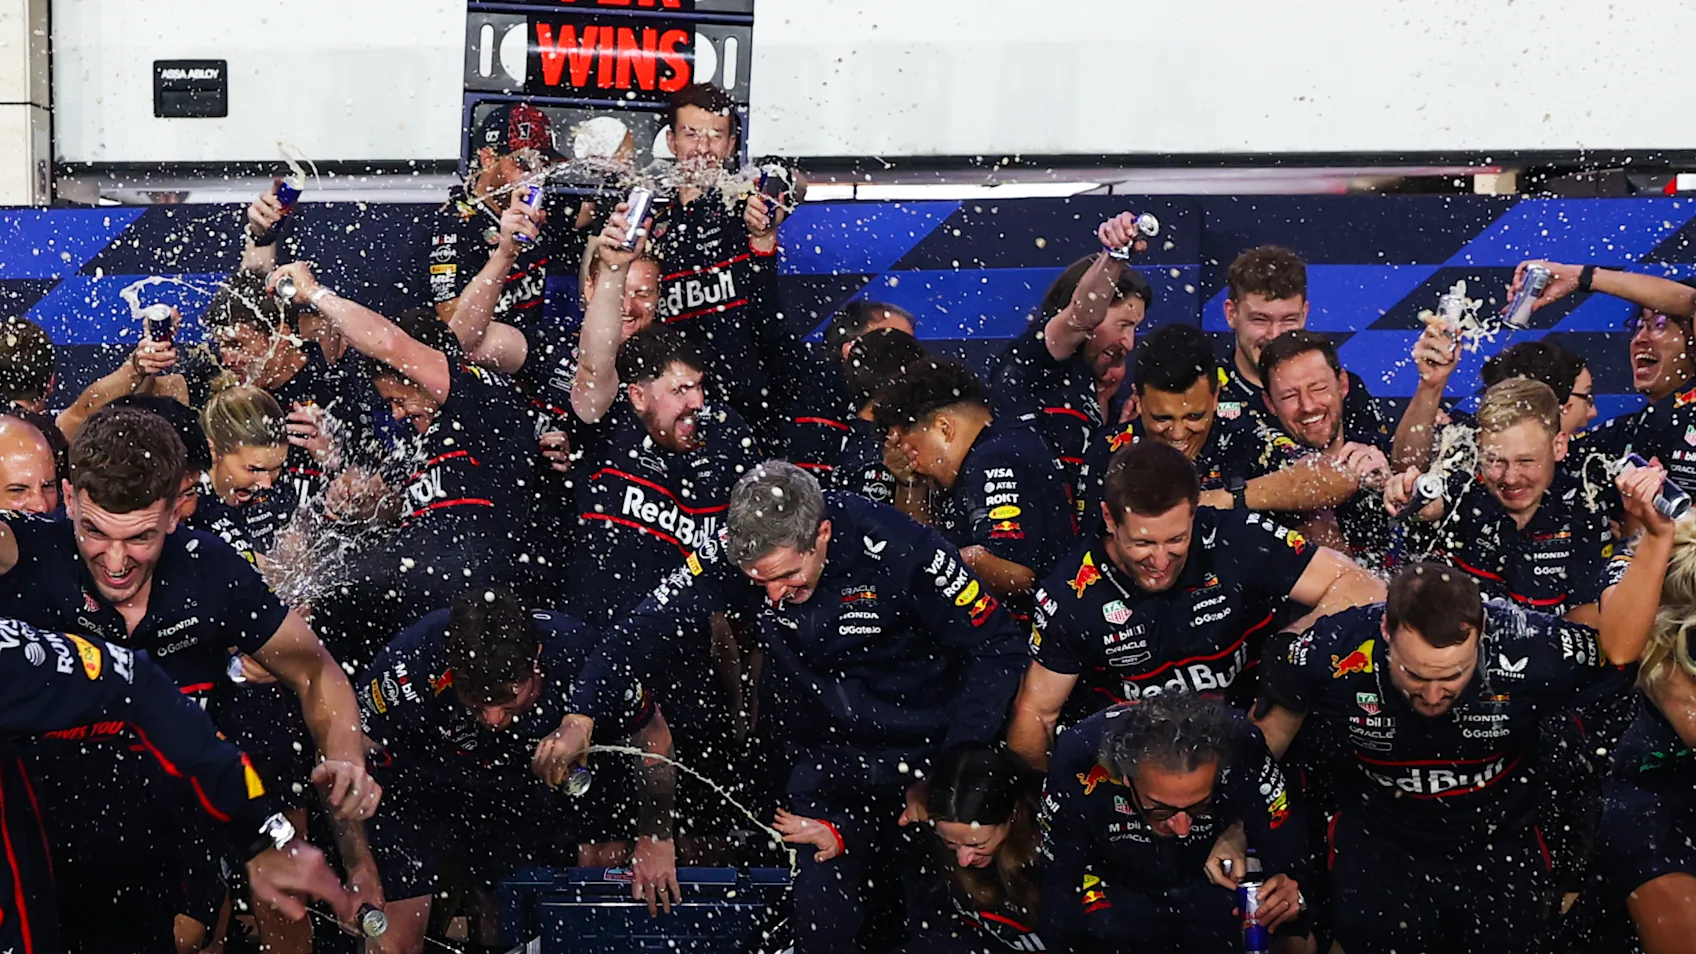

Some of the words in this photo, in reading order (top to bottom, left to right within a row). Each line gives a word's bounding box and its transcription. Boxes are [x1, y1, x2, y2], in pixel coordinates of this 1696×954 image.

[535, 23, 692, 92] WINS
[161, 69, 187, 79] ASSA
[187, 69, 219, 79] ABLOY
[658, 281, 684, 313] ed
[984, 468, 1014, 479] VISA
[1671, 464, 1696, 474] ORACL
[986, 494, 1019, 506] ROKT
[622, 485, 677, 531] Red
[673, 517, 715, 549] Bull
[925, 549, 946, 575] VISA
[943, 567, 969, 598] ROKT
[1035, 587, 1058, 616] Mobil
[157, 616, 199, 637] HONDA
[1103, 628, 1133, 645] Mobil
[1105, 640, 1147, 655] ORACLE
[1560, 628, 1573, 660] VISA
[395, 662, 418, 702] Mobil
